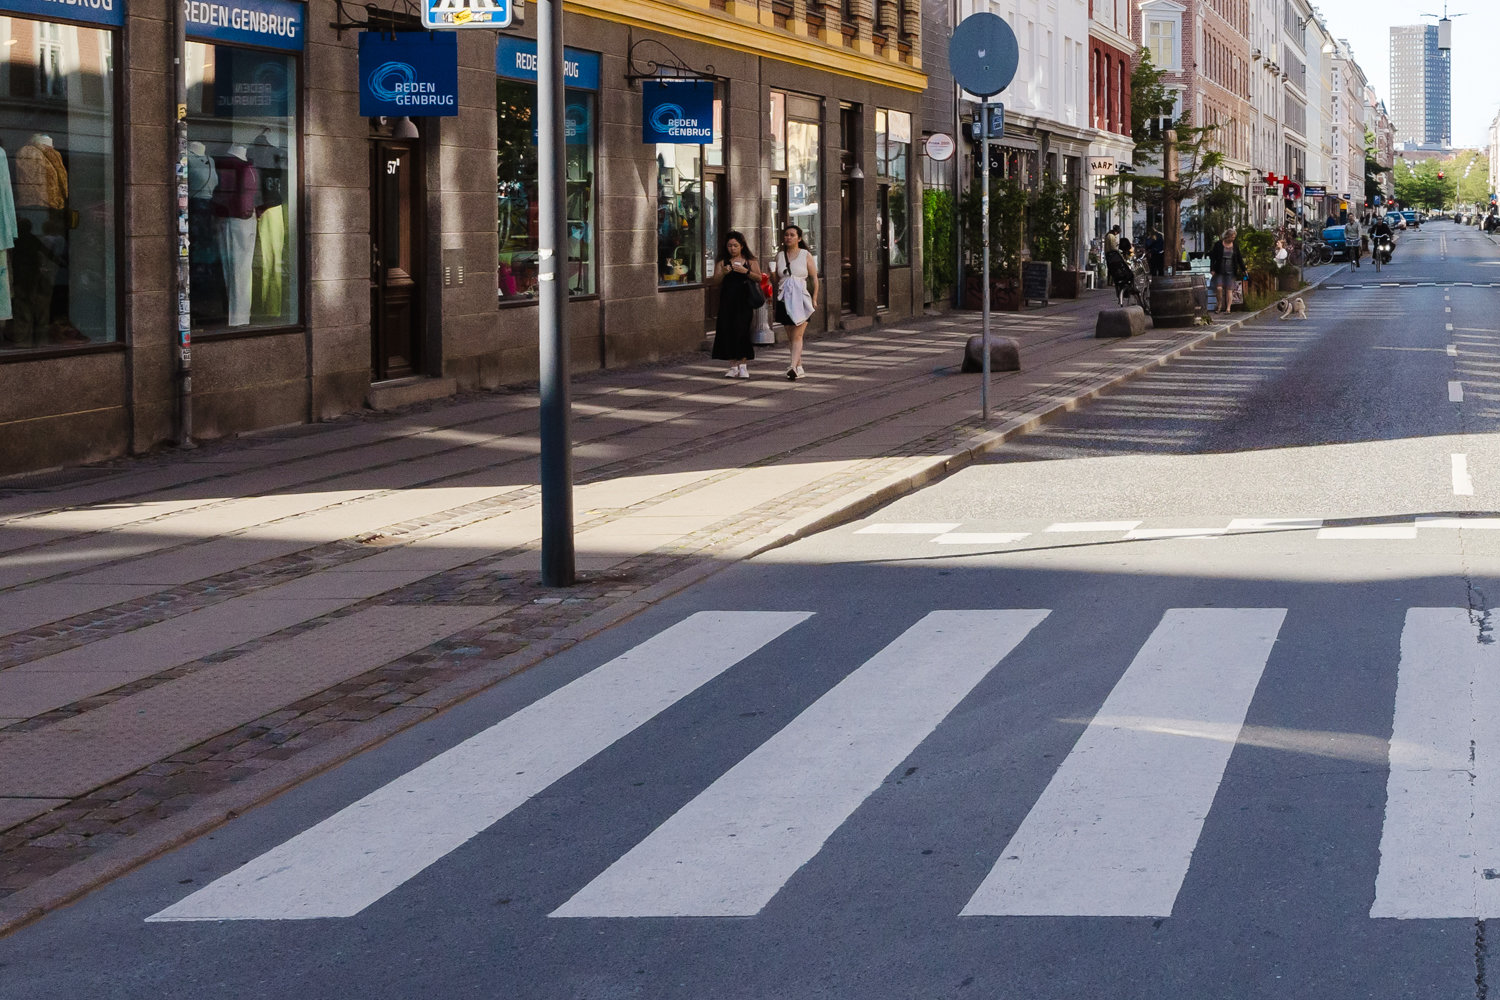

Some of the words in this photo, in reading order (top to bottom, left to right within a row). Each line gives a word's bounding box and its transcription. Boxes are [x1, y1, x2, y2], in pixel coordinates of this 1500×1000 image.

[232, 8, 295, 38] GENBRUG
[516, 52, 538, 71] REDE
[395, 82, 435, 93] REDEN
[396, 95, 454, 106] GENBRUG
[668, 119, 698, 127] REDEN
[668, 128, 711, 137] GENBRUG
[1090, 161, 1113, 170] HART
